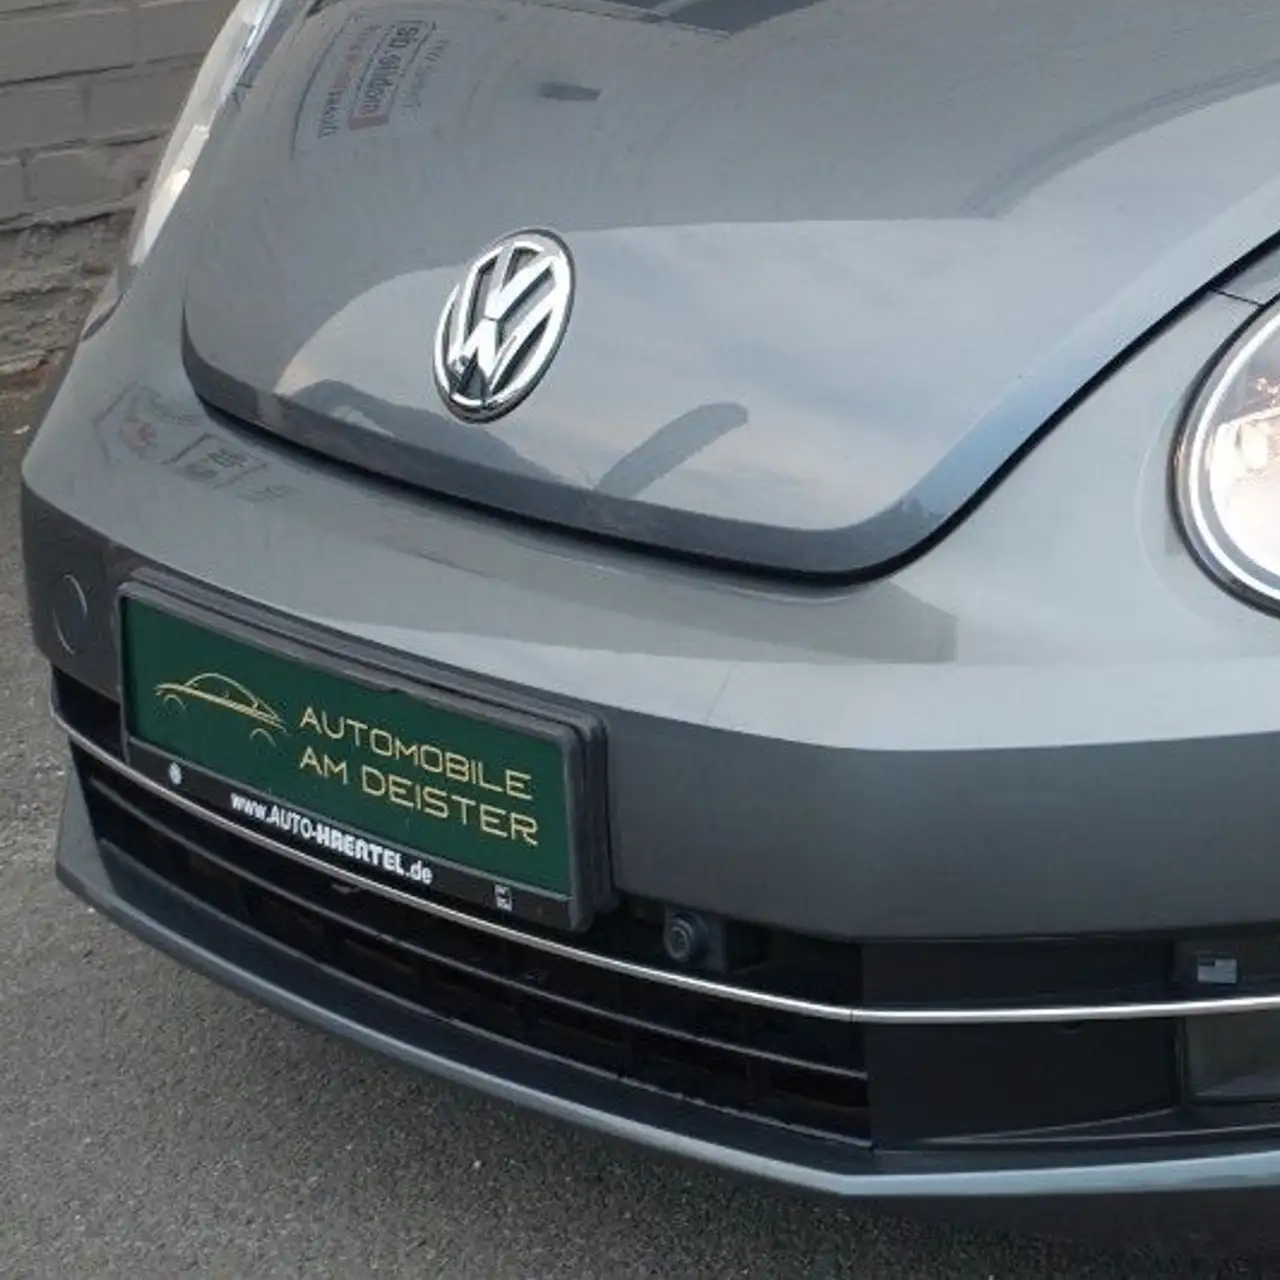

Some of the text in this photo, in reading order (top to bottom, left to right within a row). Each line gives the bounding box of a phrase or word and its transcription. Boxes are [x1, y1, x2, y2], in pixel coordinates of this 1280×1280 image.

[300, 706, 532, 799] AUTOMOBILE
[300, 747, 539, 845] AM DEISTER
